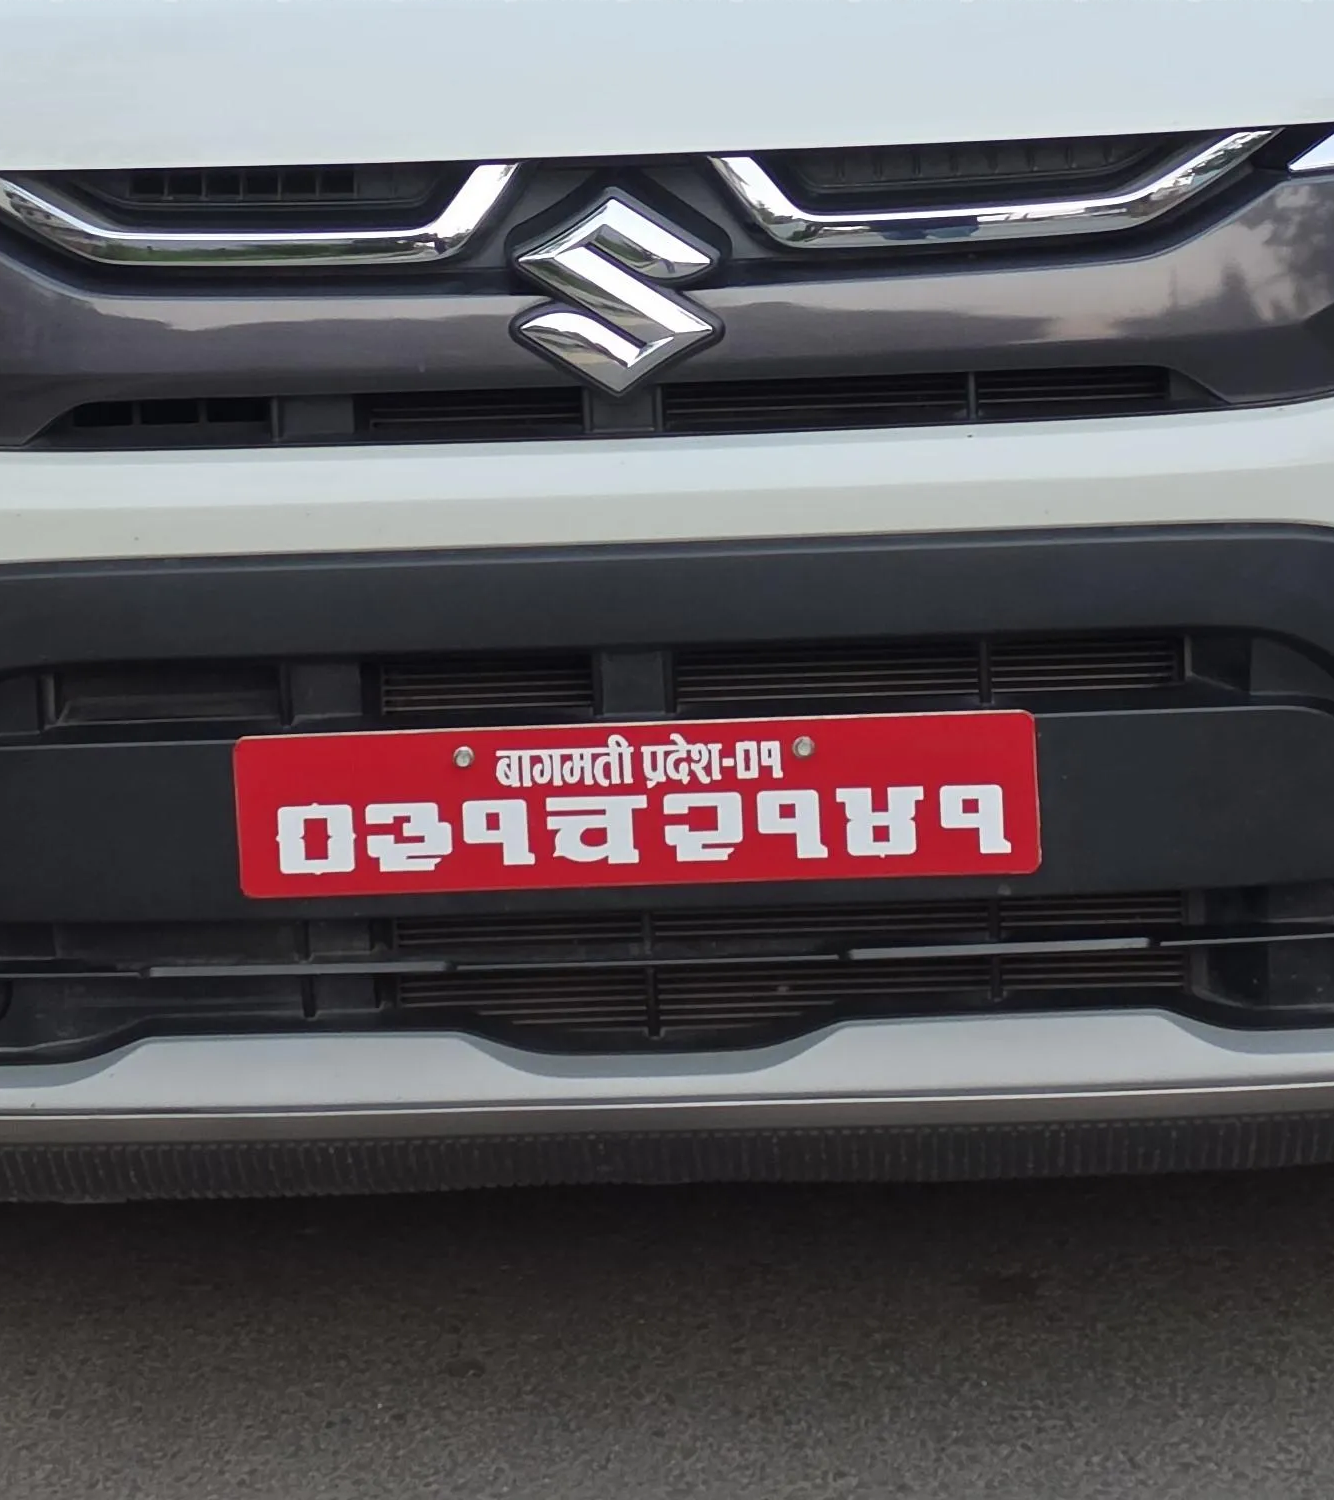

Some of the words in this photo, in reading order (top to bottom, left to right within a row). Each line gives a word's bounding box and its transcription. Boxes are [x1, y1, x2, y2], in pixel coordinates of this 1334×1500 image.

[495, 734, 634, 788] बागमती
[640, 733, 783, 789] प्रदेश-०१
[276, 784, 1012, 875] ०३१च२१४१
